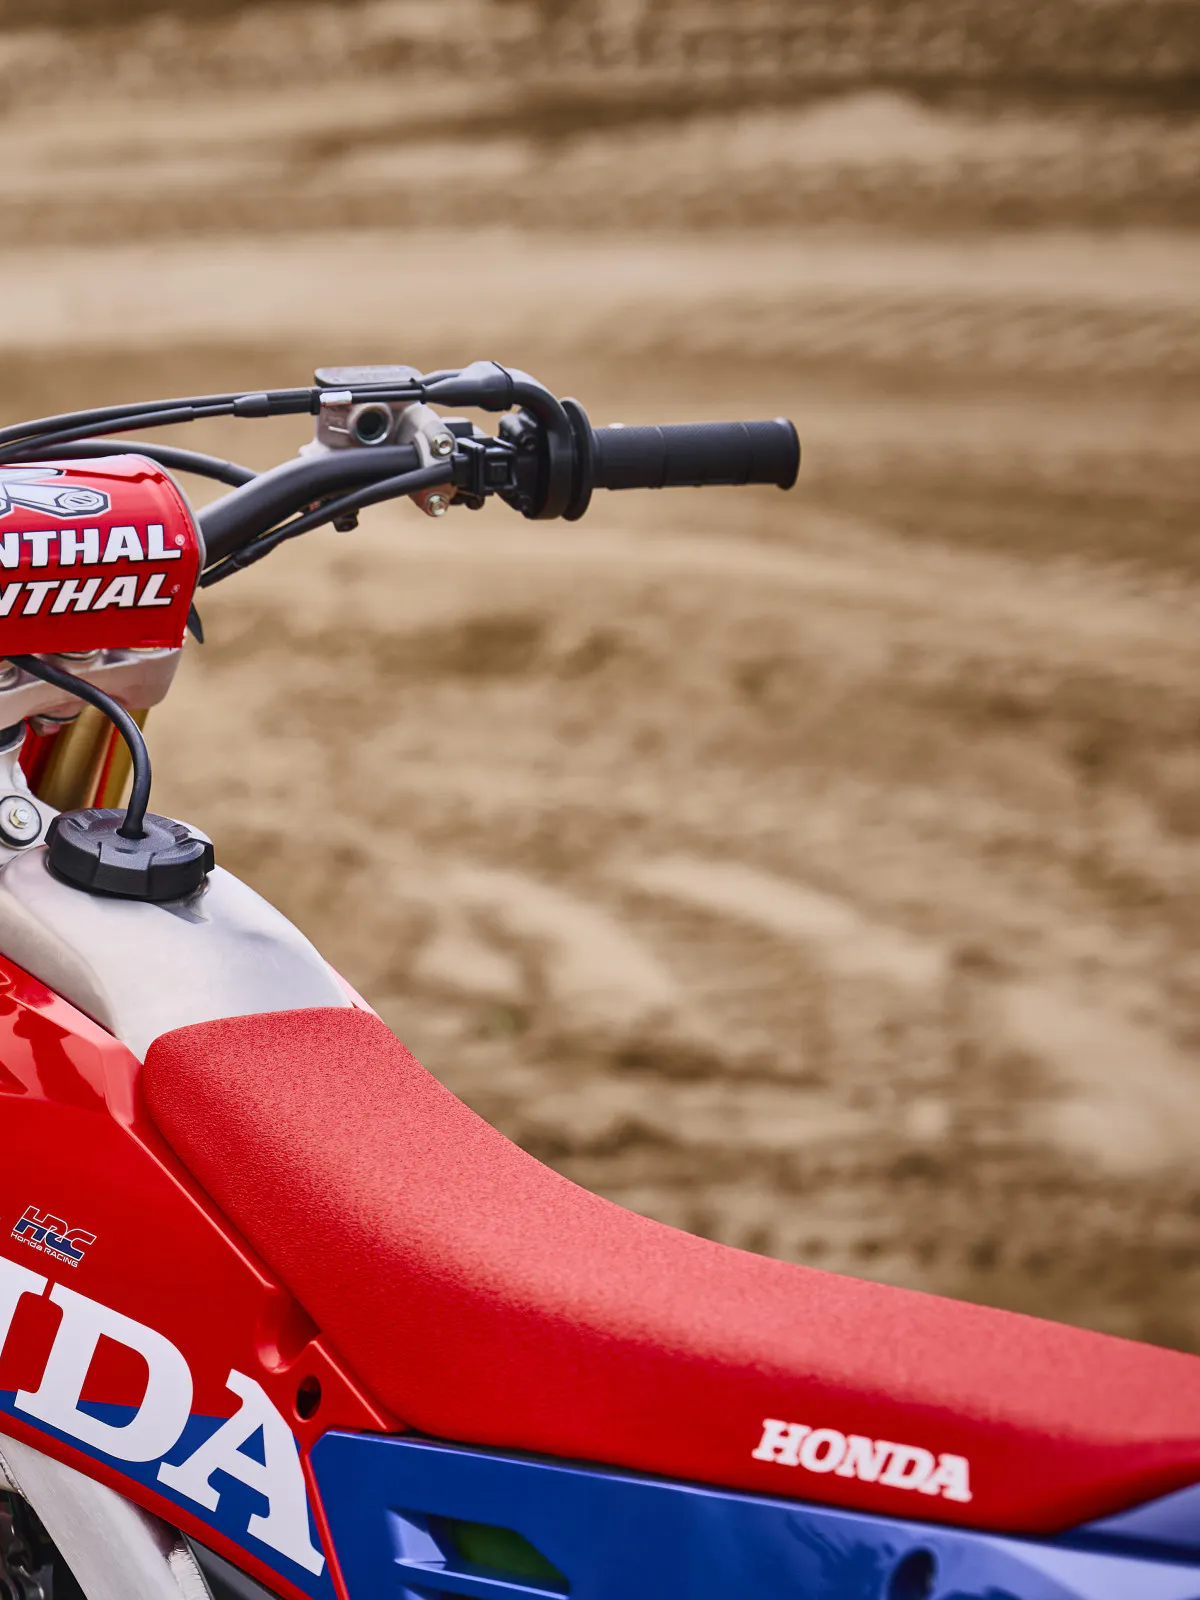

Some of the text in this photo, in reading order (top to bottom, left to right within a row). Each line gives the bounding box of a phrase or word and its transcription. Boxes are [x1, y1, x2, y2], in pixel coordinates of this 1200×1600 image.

[10, 1231, 79, 1268] Honda RACING
[12, 1205, 97, 1262] HRC
[751, 1418, 973, 1503] HONDA
